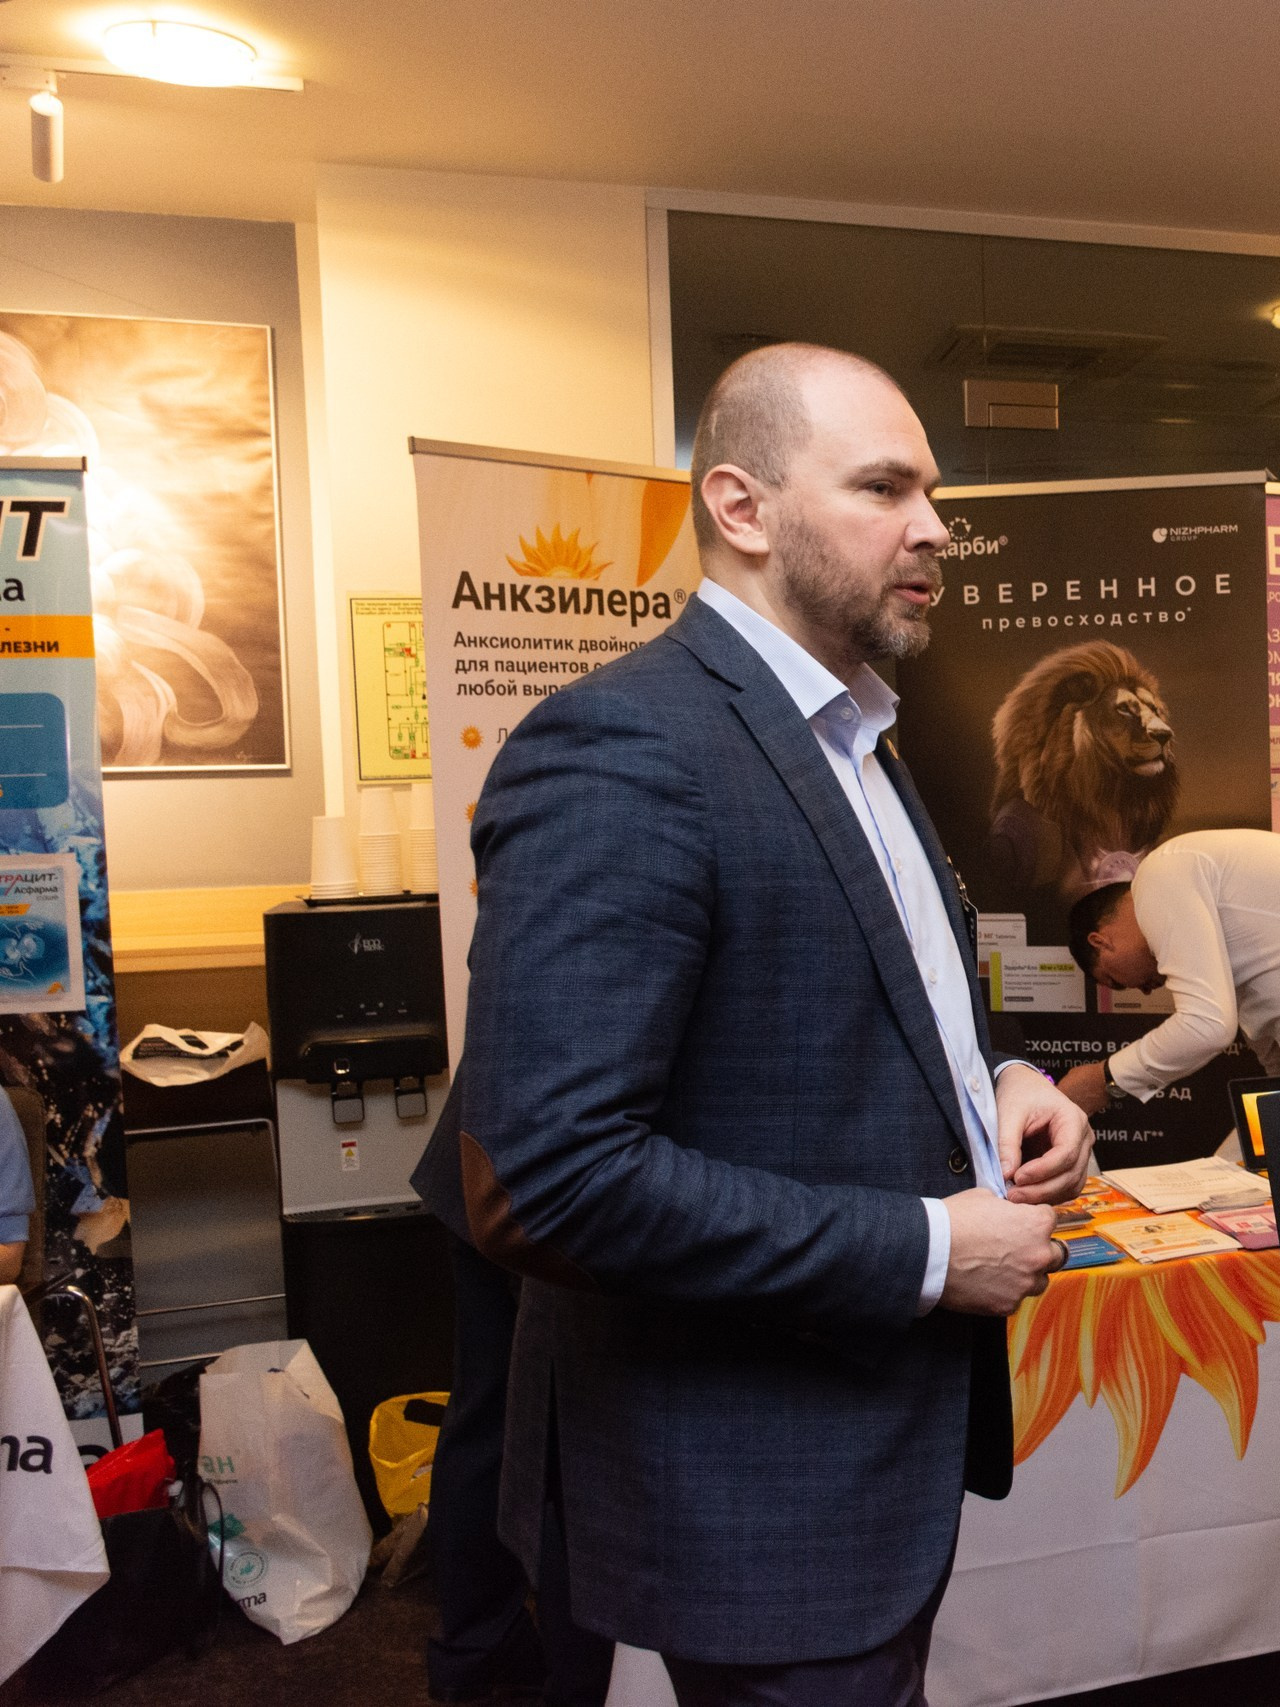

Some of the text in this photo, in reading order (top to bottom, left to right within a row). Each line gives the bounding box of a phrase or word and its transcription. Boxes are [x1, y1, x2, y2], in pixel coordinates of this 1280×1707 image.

[1169, 524, 1239, 537] NIZHPHARM
[453, 631, 575, 651] Анксиолитик
[455, 658, 490, 675] для
[494, 659, 589, 676] пациентов
[456, 678, 518, 697] любой
[1169, 1087, 1192, 1101] АД
